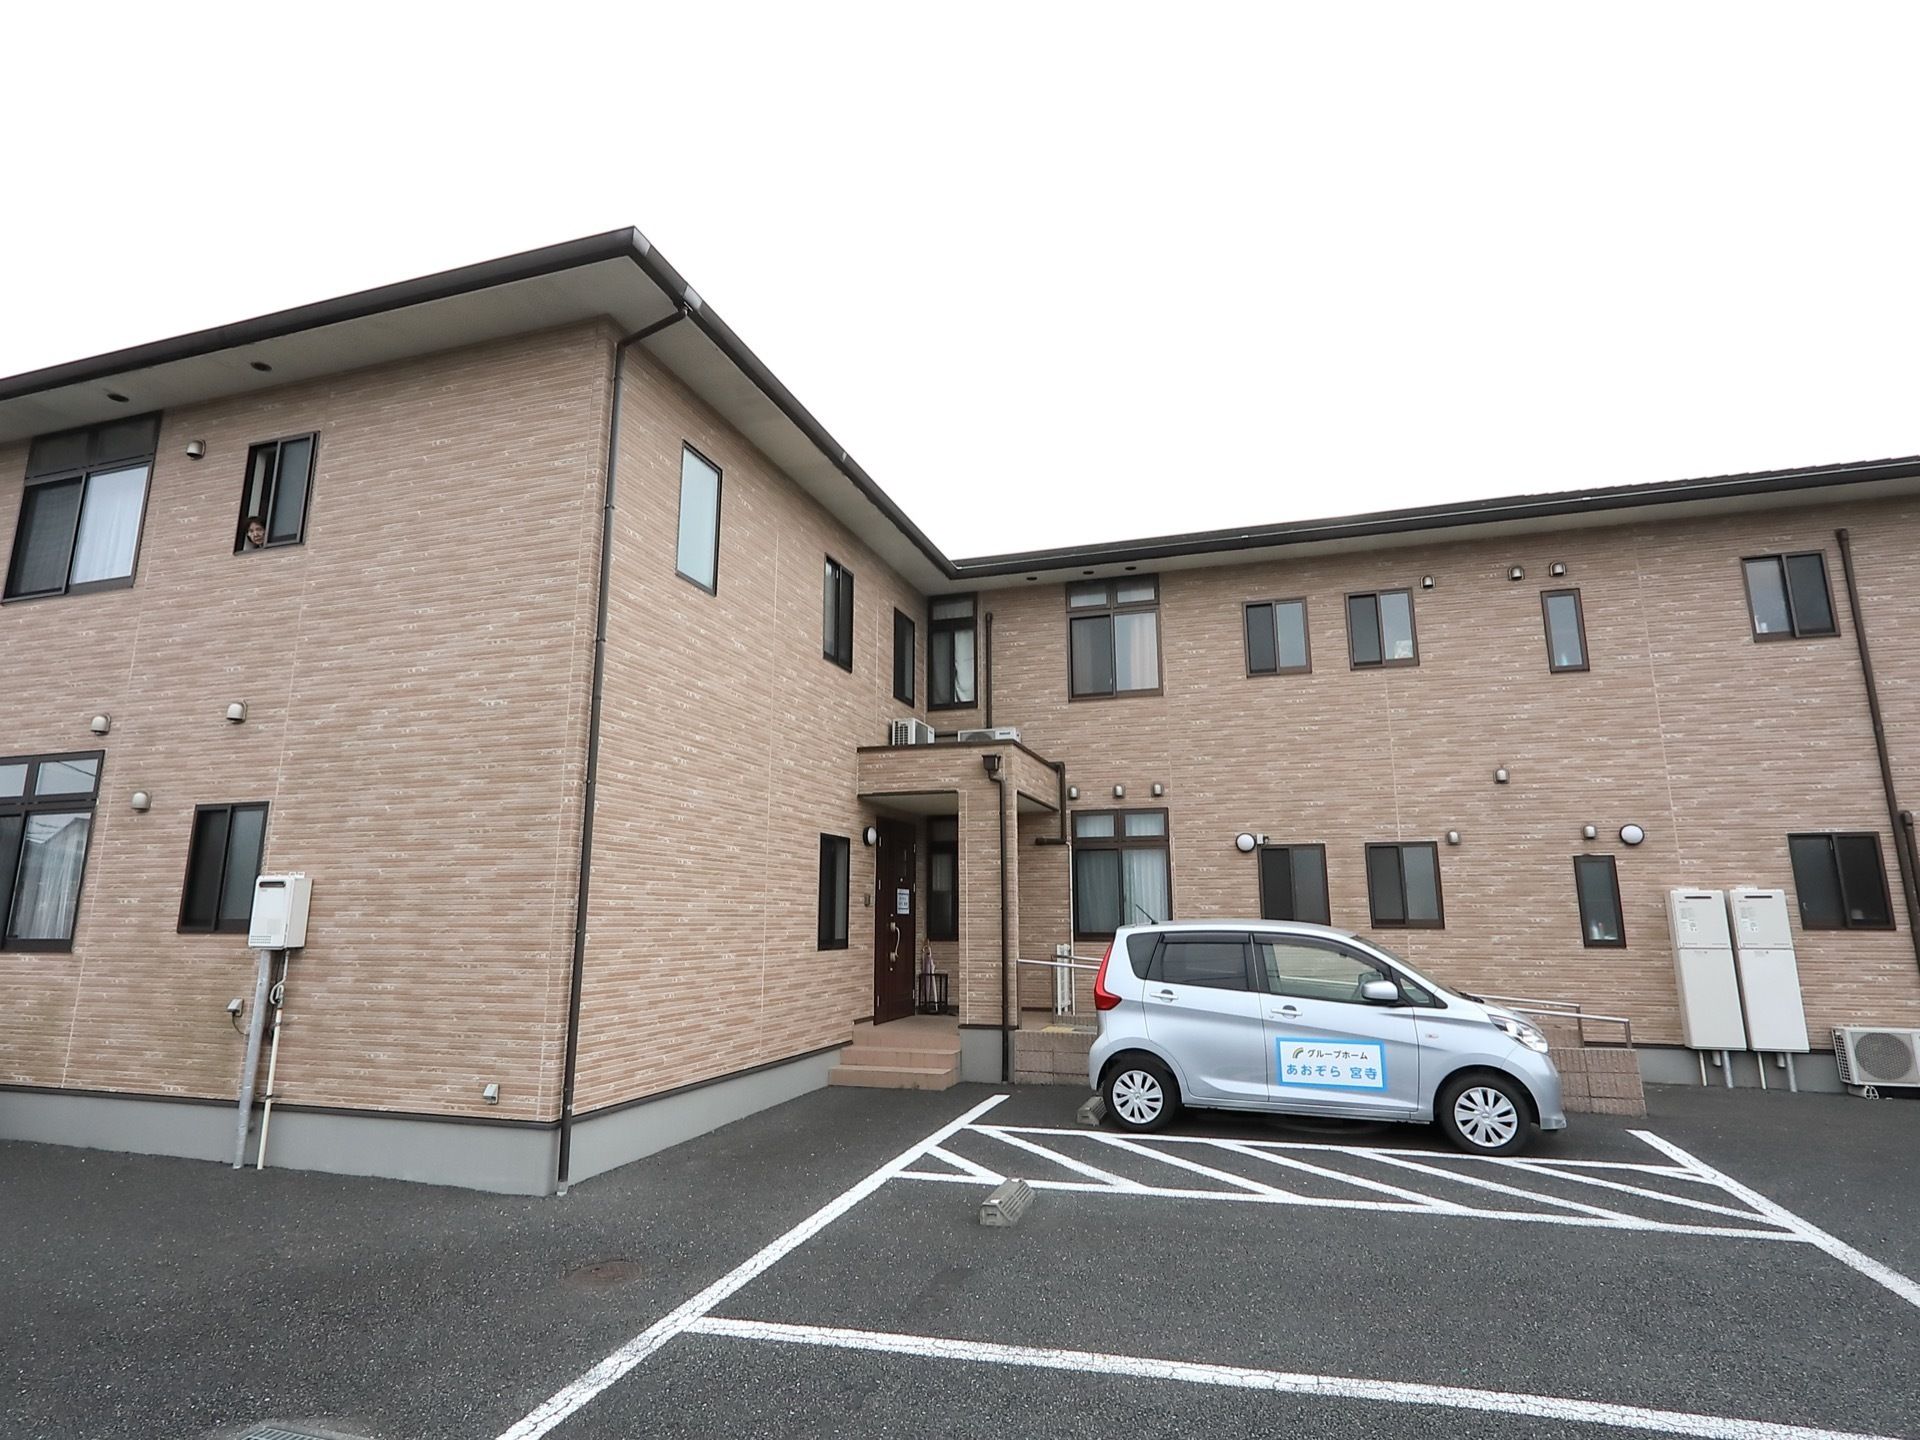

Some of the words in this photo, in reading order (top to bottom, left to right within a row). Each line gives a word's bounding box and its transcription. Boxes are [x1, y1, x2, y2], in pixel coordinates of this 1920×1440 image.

[1307, 1049, 1368, 1060] グループホーム
[1286, 1064, 1341, 1077] あおぞら
[1350, 1067, 1378, 1080] 宮寺
